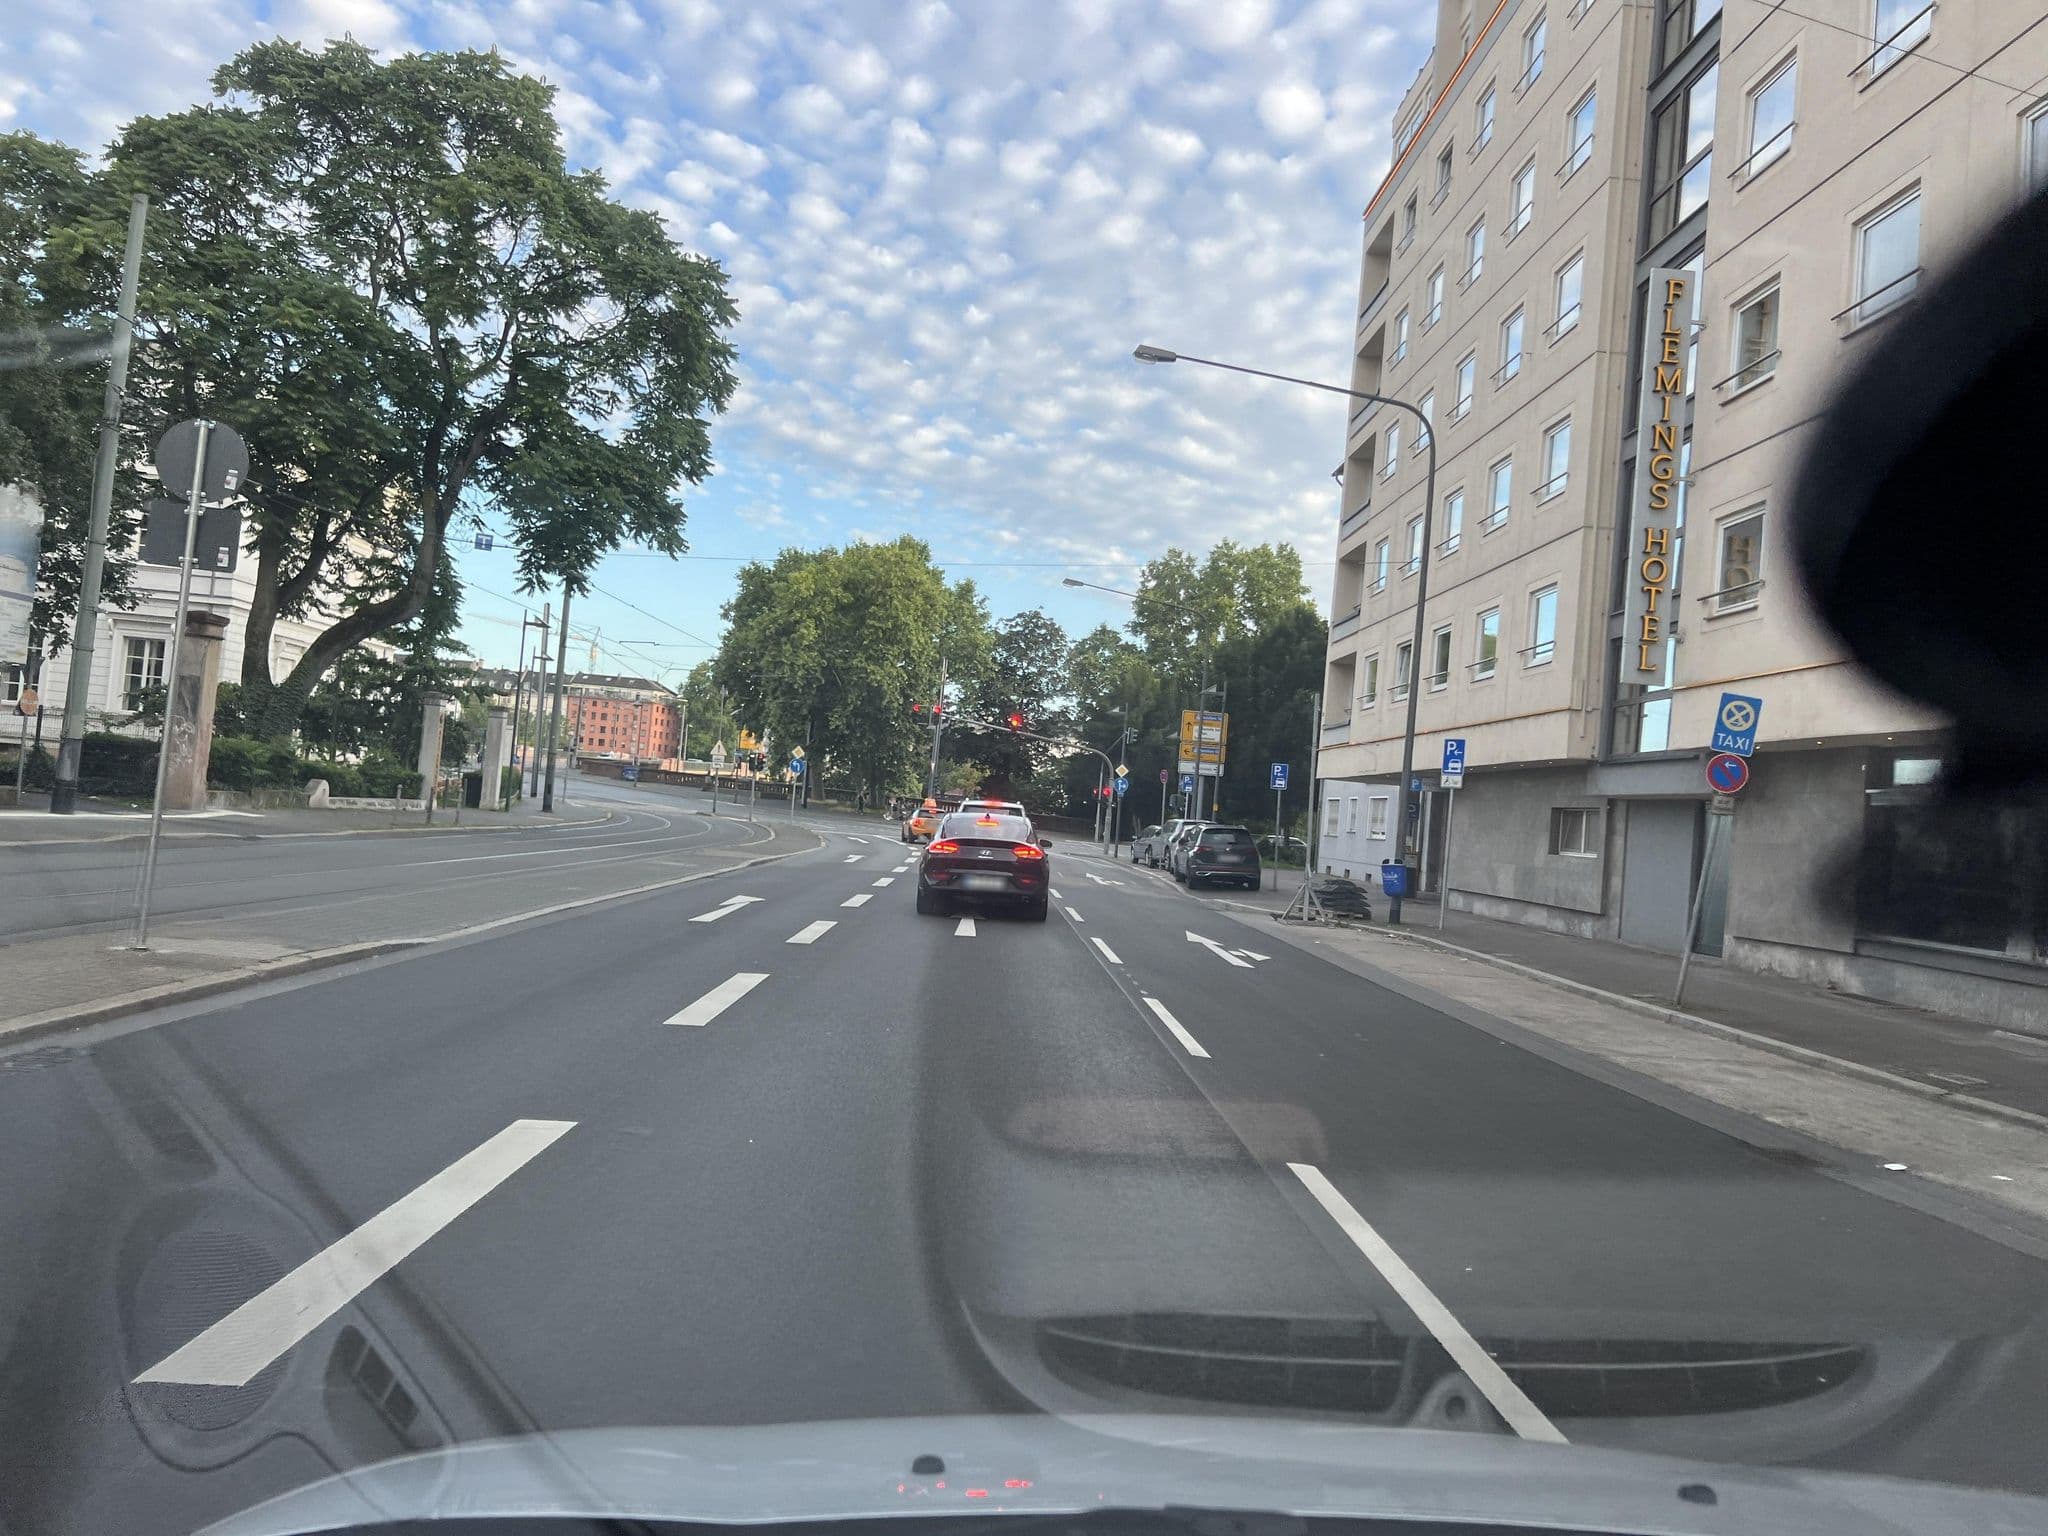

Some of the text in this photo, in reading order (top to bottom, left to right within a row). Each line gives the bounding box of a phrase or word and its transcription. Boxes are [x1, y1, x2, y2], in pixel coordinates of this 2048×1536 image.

[1637, 278, 1686, 672] FLEMINGS HOTEL
[1446, 741, 1457, 756] P
[1716, 732, 1750, 751] TAXI
[1273, 765, 1282, 776] P
